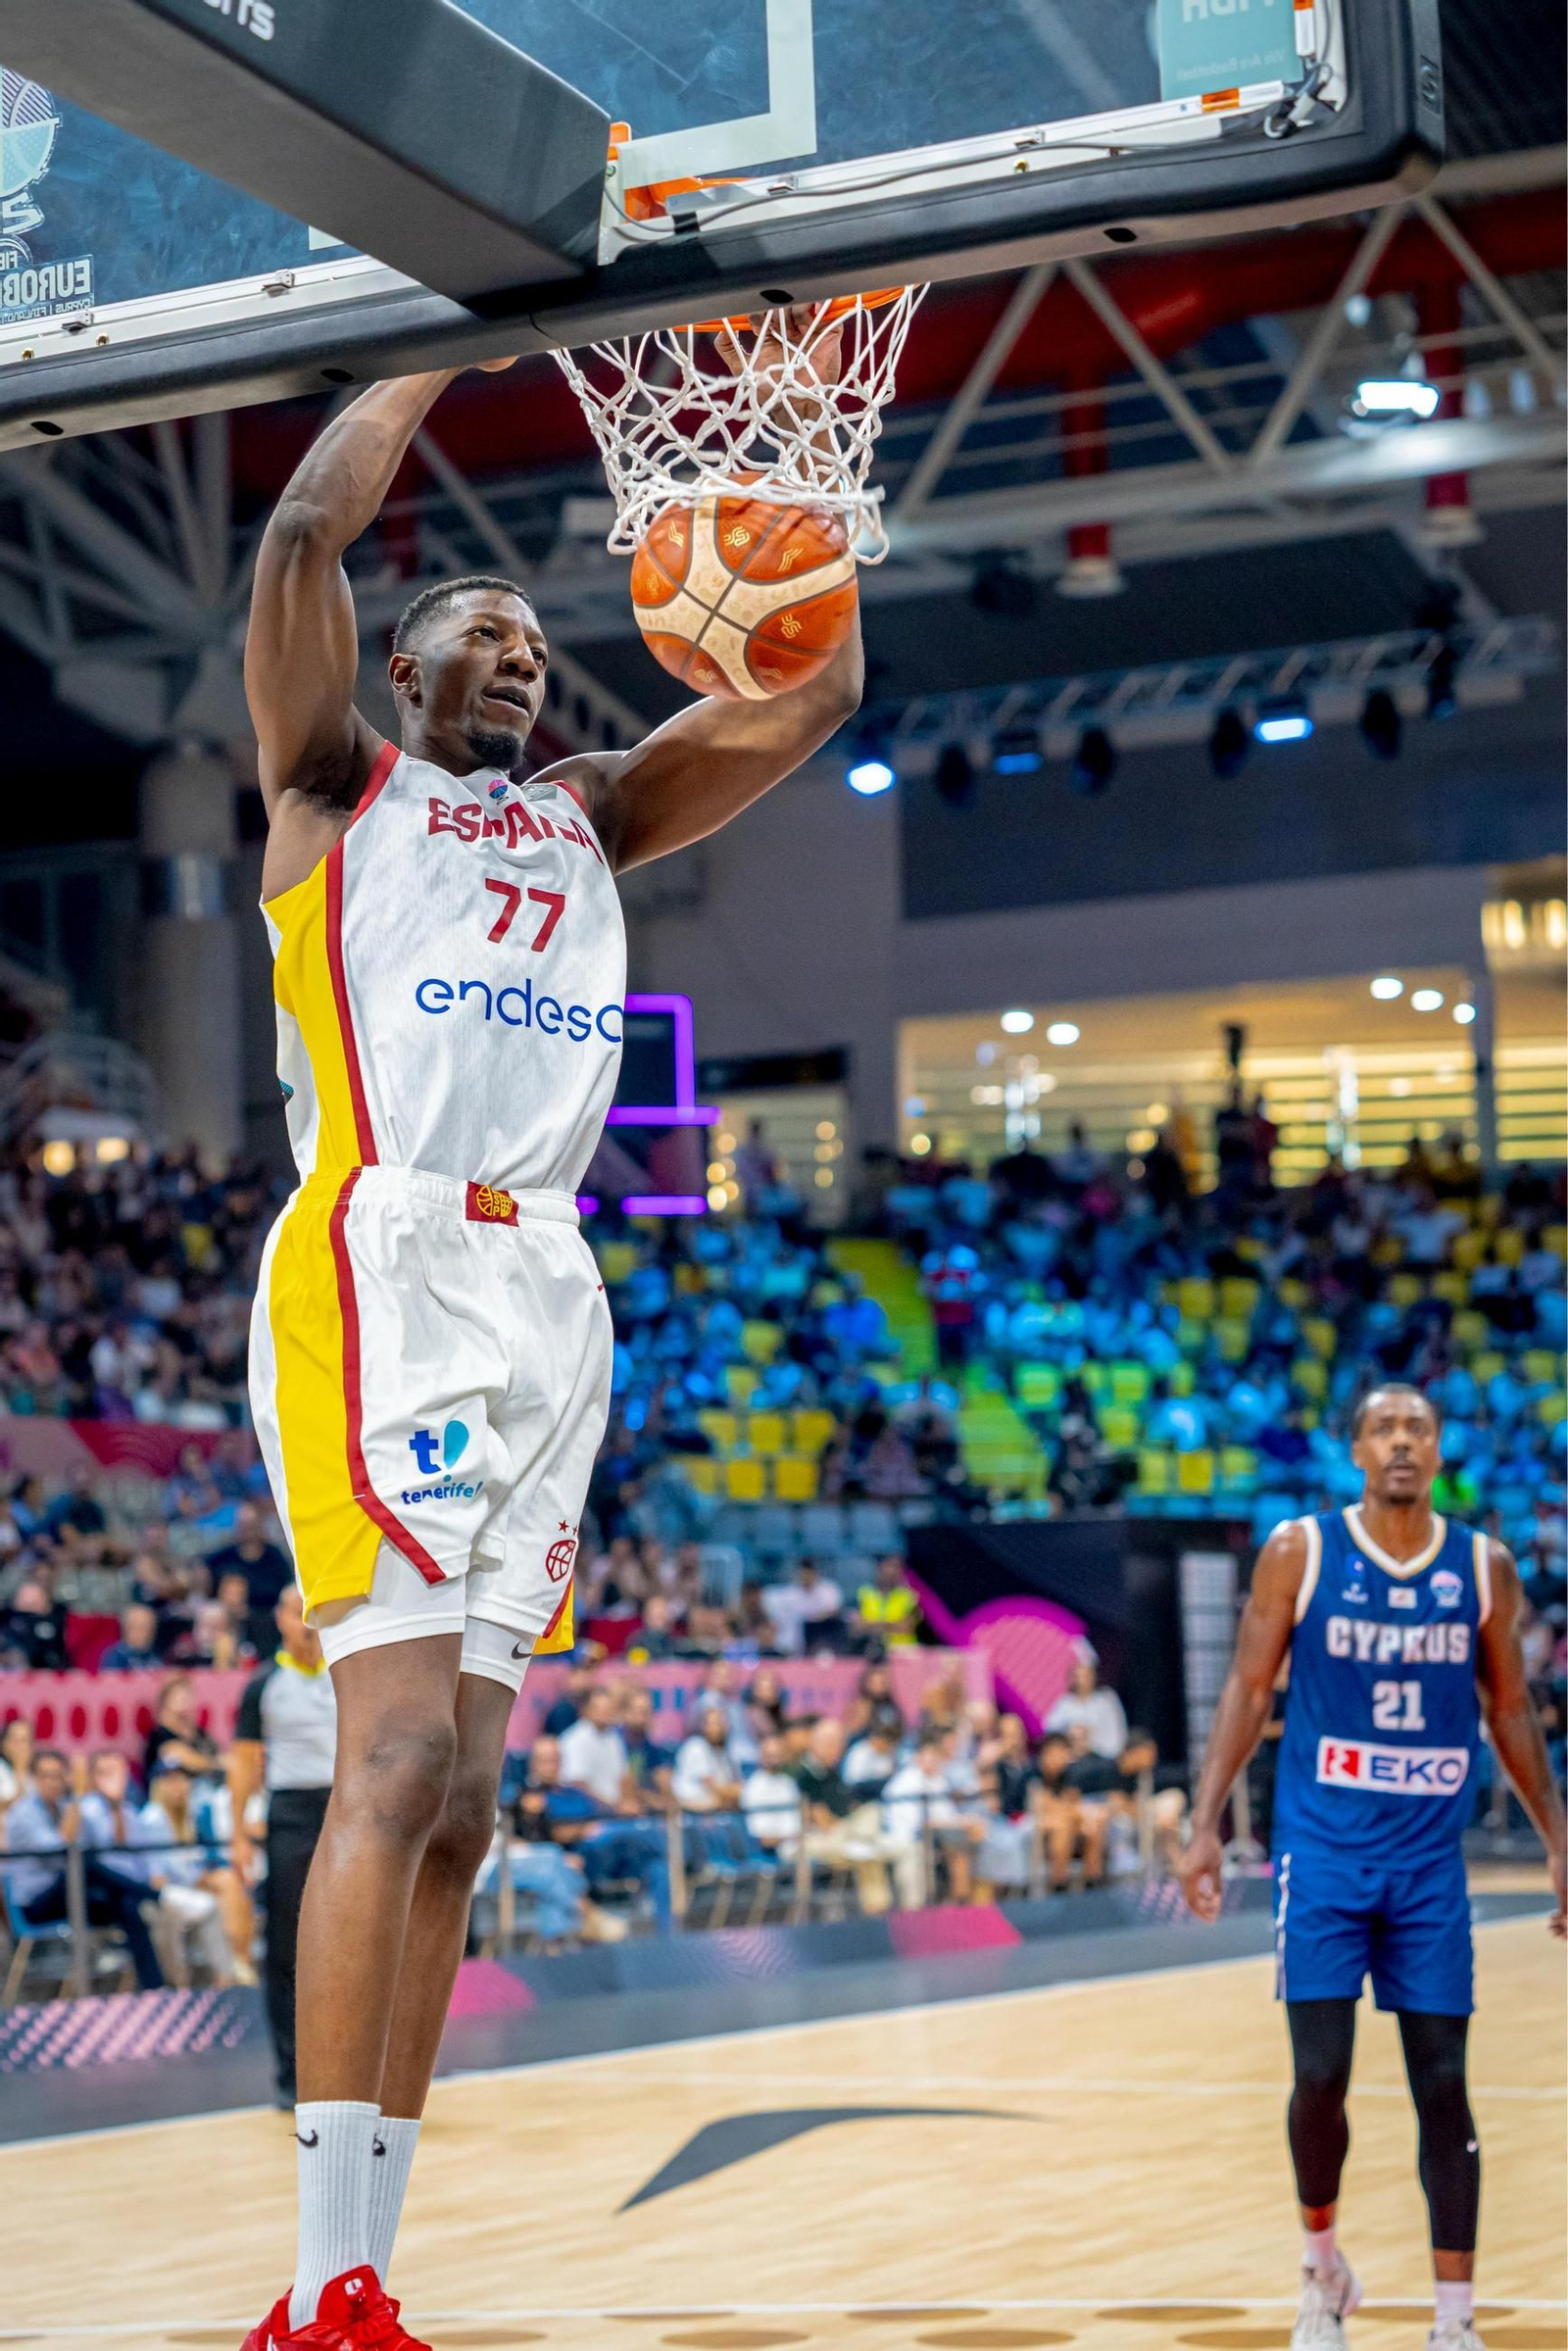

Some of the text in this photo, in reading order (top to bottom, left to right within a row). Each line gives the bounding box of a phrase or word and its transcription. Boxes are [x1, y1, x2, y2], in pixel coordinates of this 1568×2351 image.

[485, 877, 565, 953] 77
[1326, 1615, 1470, 1664] CYPRUS
[1372, 1679, 1426, 1732] 21
[1370, 1754, 1462, 1785] EKO
